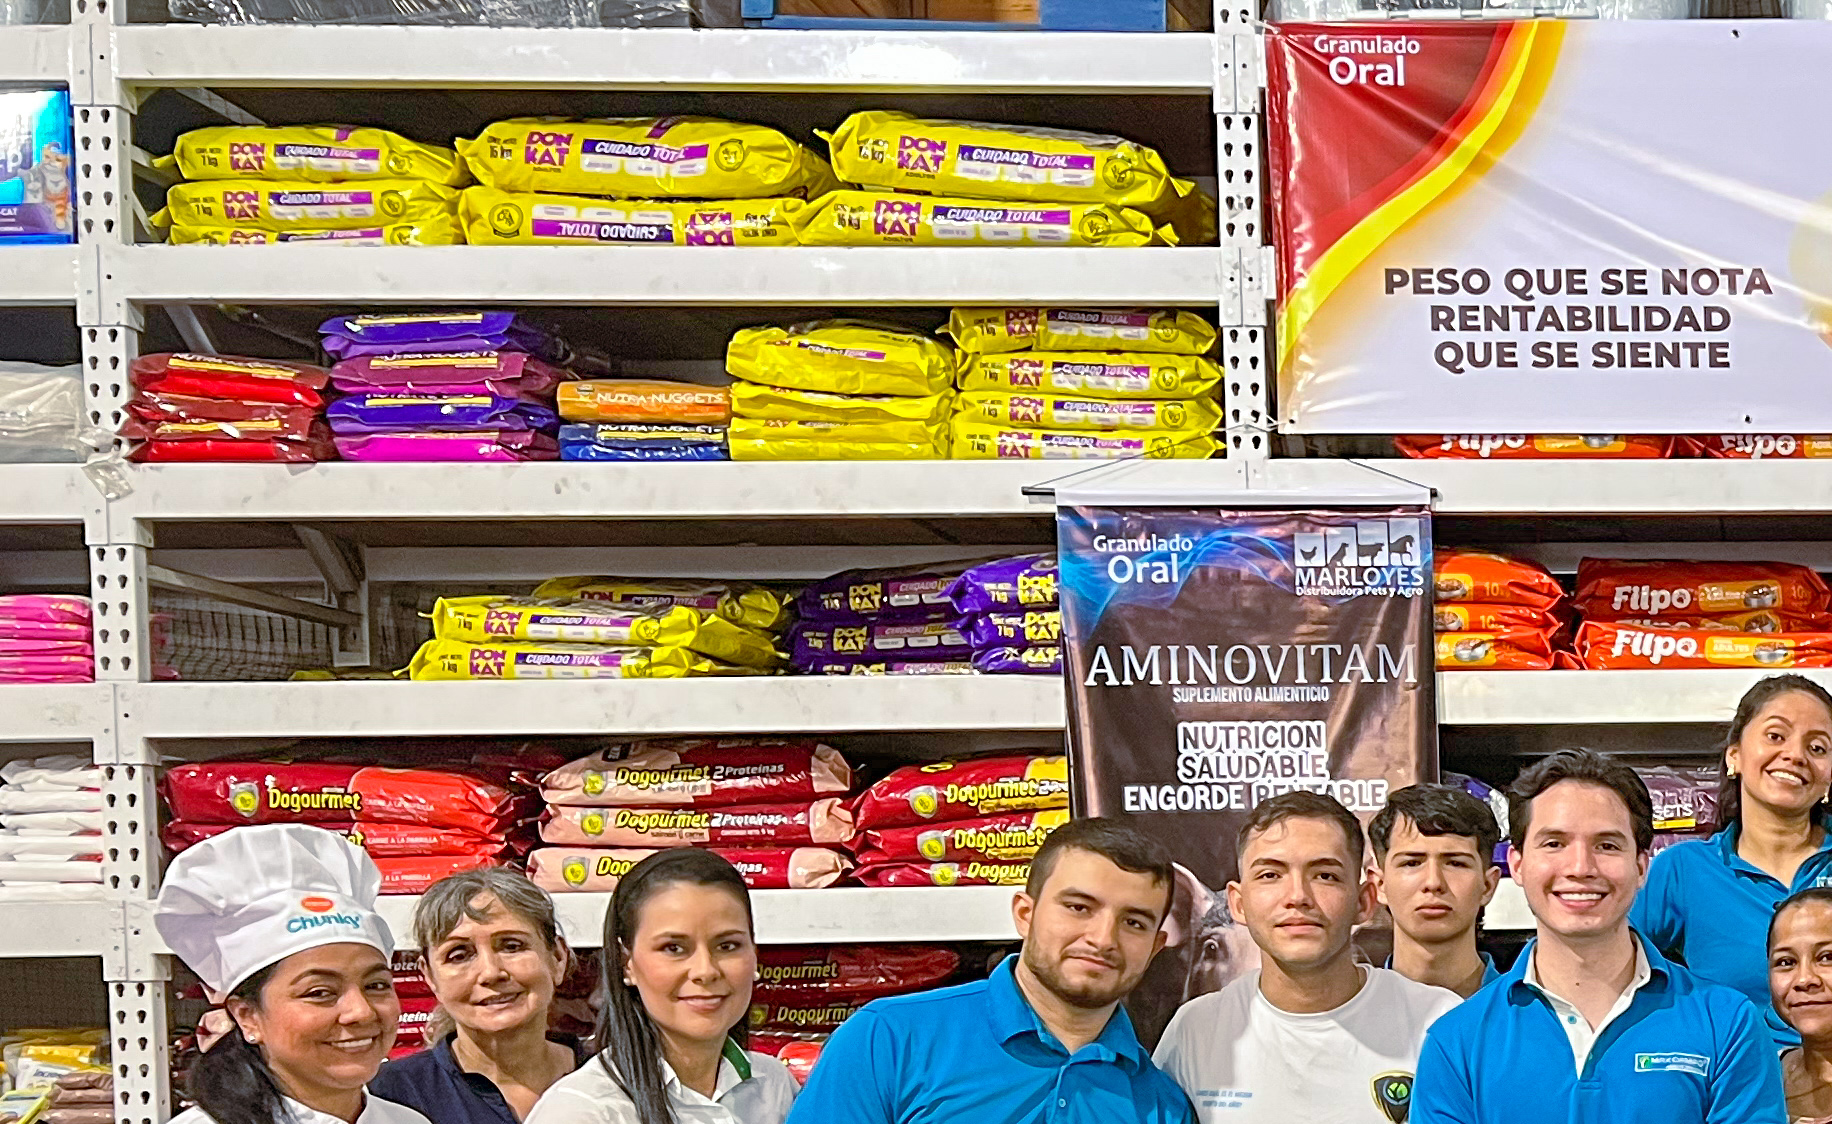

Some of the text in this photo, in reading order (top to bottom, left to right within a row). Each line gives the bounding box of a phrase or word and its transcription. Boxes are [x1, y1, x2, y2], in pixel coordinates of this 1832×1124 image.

[1313, 35, 1420, 56] Granulado
[1328, 56, 1406, 86] Oral
[526, 132, 573, 145] DON
[900, 136, 947, 152] DON
[230, 143, 265, 154] DON
[525, 146, 570, 165] KAT
[595, 142, 650, 156] CUIDADO
[230, 155, 265, 171] KAT
[898, 151, 943, 172] KAT
[972, 148, 1071, 168] CUIDADO TOTAL
[224, 192, 258, 203] DON
[224, 204, 259, 219] KAT
[947, 207, 1045, 222] CUIDADO TOTAL
[1384, 267, 1773, 300] PESO QUE SE NOTA
[1430, 304, 1732, 332] RENTABILIDAD
[1434, 341, 1731, 374] QUE SE SIENTE
[1010, 371, 1042, 386] KAT
[1093, 534, 1193, 553] Granulado
[1107, 555, 1179, 584] Oral
[1295, 567, 1424, 586] MARLOYES
[850, 584, 882, 595] DON
[1018, 574, 1054, 588] DON
[1018, 589, 1054, 604] KAT
[1296, 587, 1424, 598] Distribuidora Pets y Agro
[1612, 586, 1692, 616] Filpo
[850, 596, 880, 610] KAT
[487, 611, 522, 621] DON
[540, 615, 612, 626] CUIDADO TOTAL
[1025, 612, 1060, 624] DON
[485, 622, 519, 634] KAT
[1025, 625, 1060, 640] KAT
[834, 637, 867, 651] KAT
[1612, 629, 1698, 665] Filpo
[470, 649, 507, 661] DON
[526, 654, 600, 666] CUIDADO TOTAL
[1022, 648, 1060, 663] KAT
[470, 661, 504, 676] KAT
[1084, 643, 1418, 687] AMINOVITAM
[1172, 686, 1329, 703] SUPLEMENTO ALIMENTICIO
[1182, 725, 1323, 750] NUTRICION
[616, 763, 784, 785] Dogourmet 2 Proteínas
[1181, 754, 1327, 779] SALUDABLE
[268, 787, 362, 813] Dogourmet
[946, 779, 1037, 806] Dogourmet
[1124, 785, 1245, 811] ENGORDE
[615, 810, 710, 833] Dogourmet
[711, 814, 722, 827] 2
[721, 813, 782, 827] Proteínas
[954, 828, 1045, 853] Dogourmet
[968, 861, 1030, 881] Dogour
[287, 913, 360, 933] Chunky
[777, 1006, 862, 1026] Dogourm
